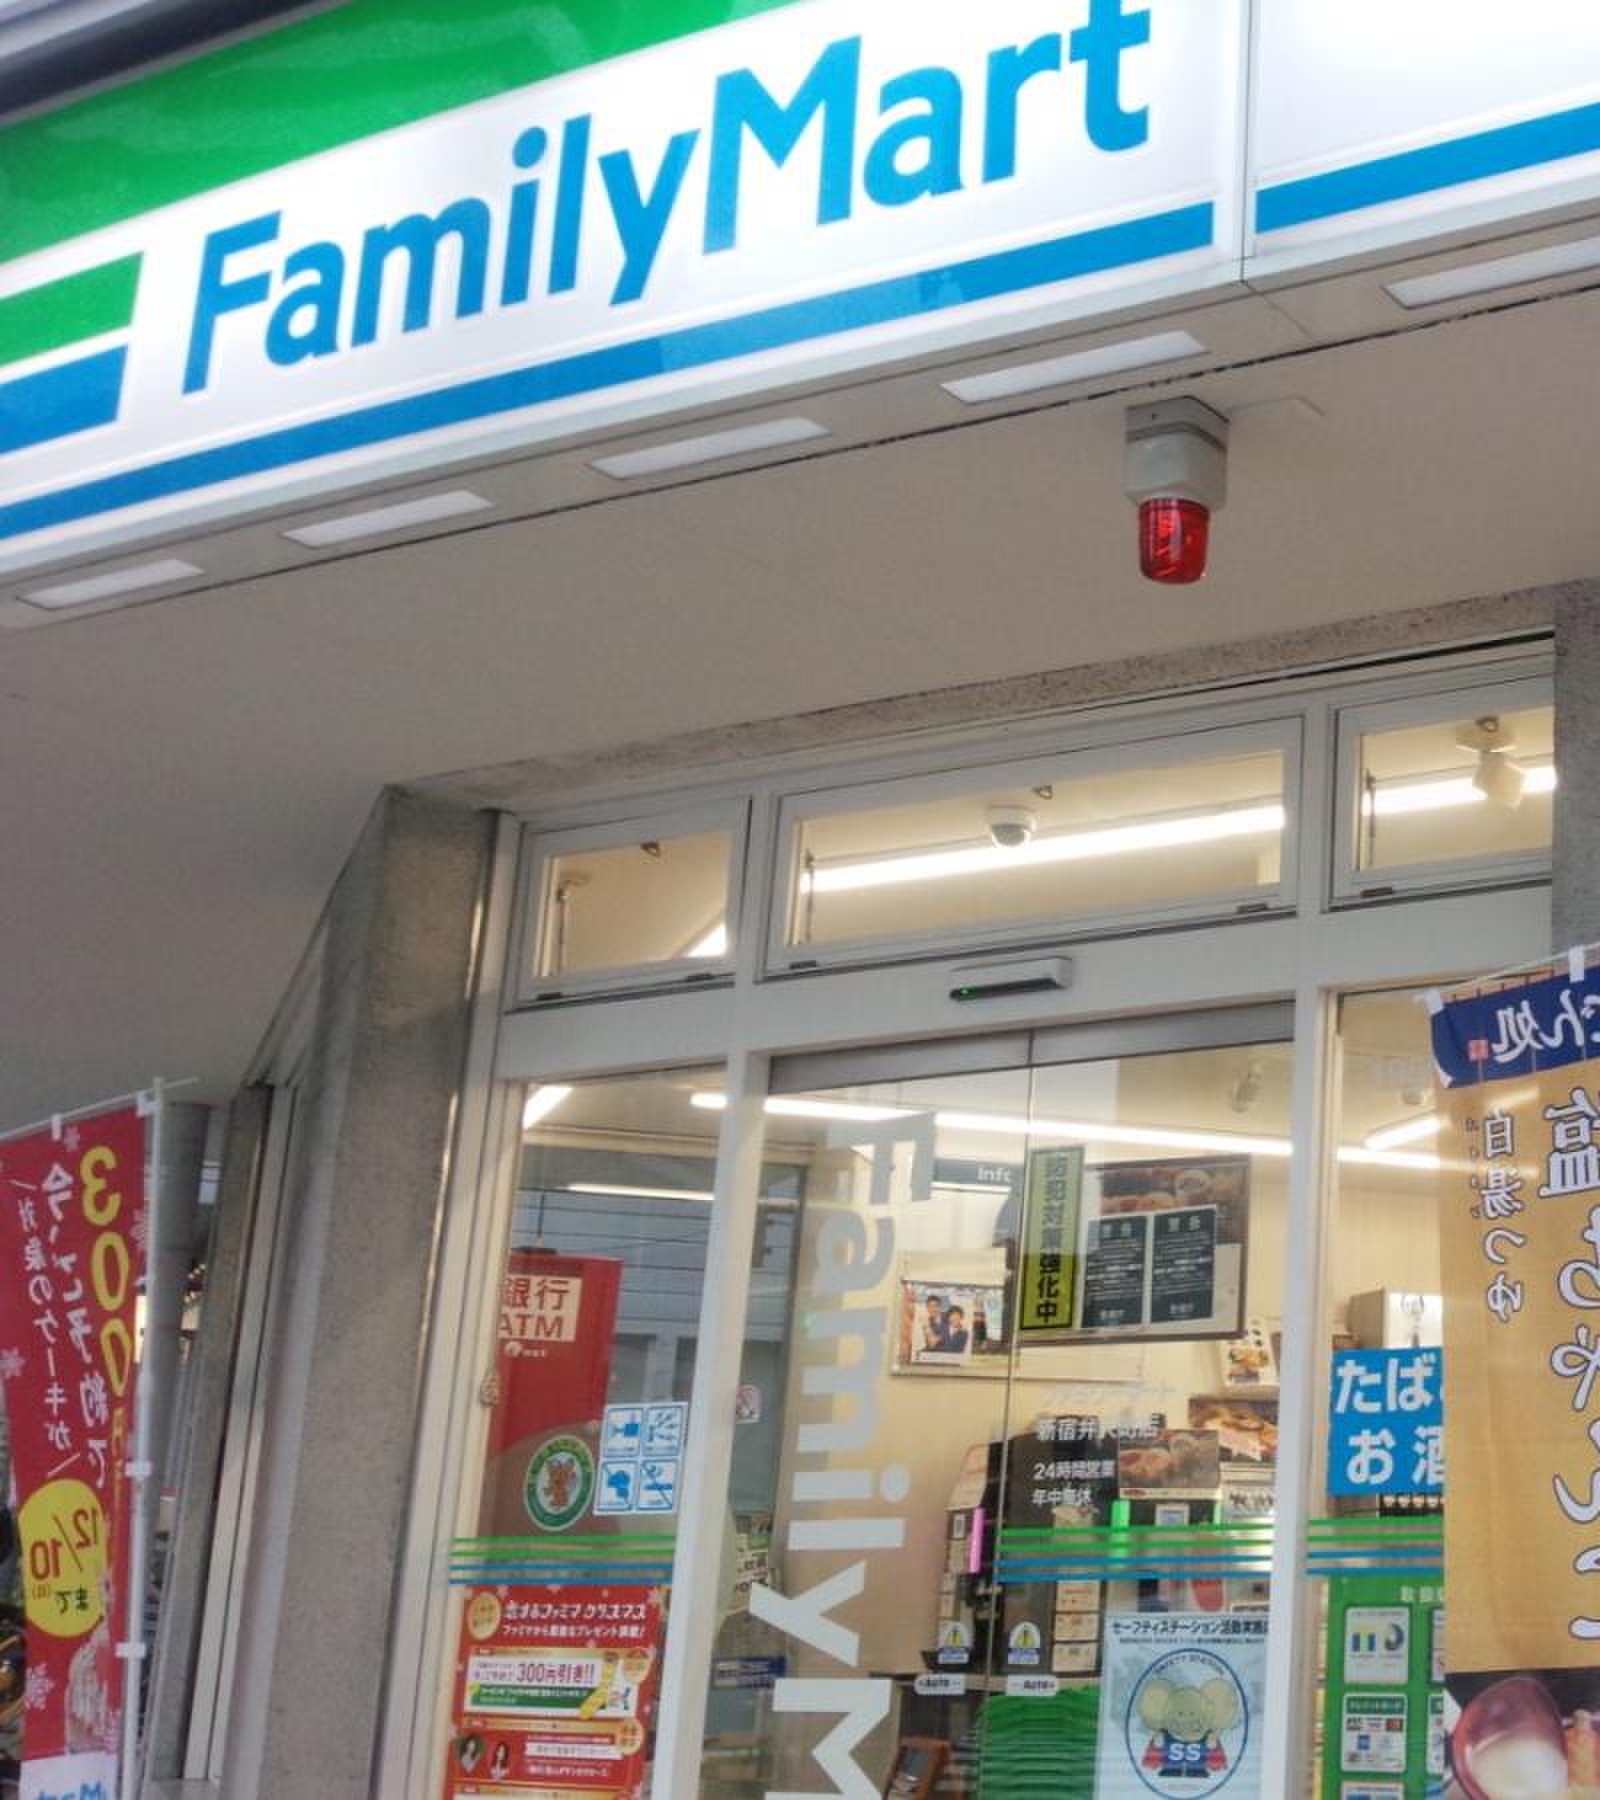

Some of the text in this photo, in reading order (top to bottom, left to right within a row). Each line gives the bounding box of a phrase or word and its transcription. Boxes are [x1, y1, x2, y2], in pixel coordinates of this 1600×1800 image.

[182, 0, 1152, 397] FamilyMart
[496, 1313, 564, 1339] ATM
[1335, 1353, 1444, 1415] たば
[1112, 1619, 1269, 1635] セーフティステーション活動実施
[1168, 1743, 1202, 1762] SS
